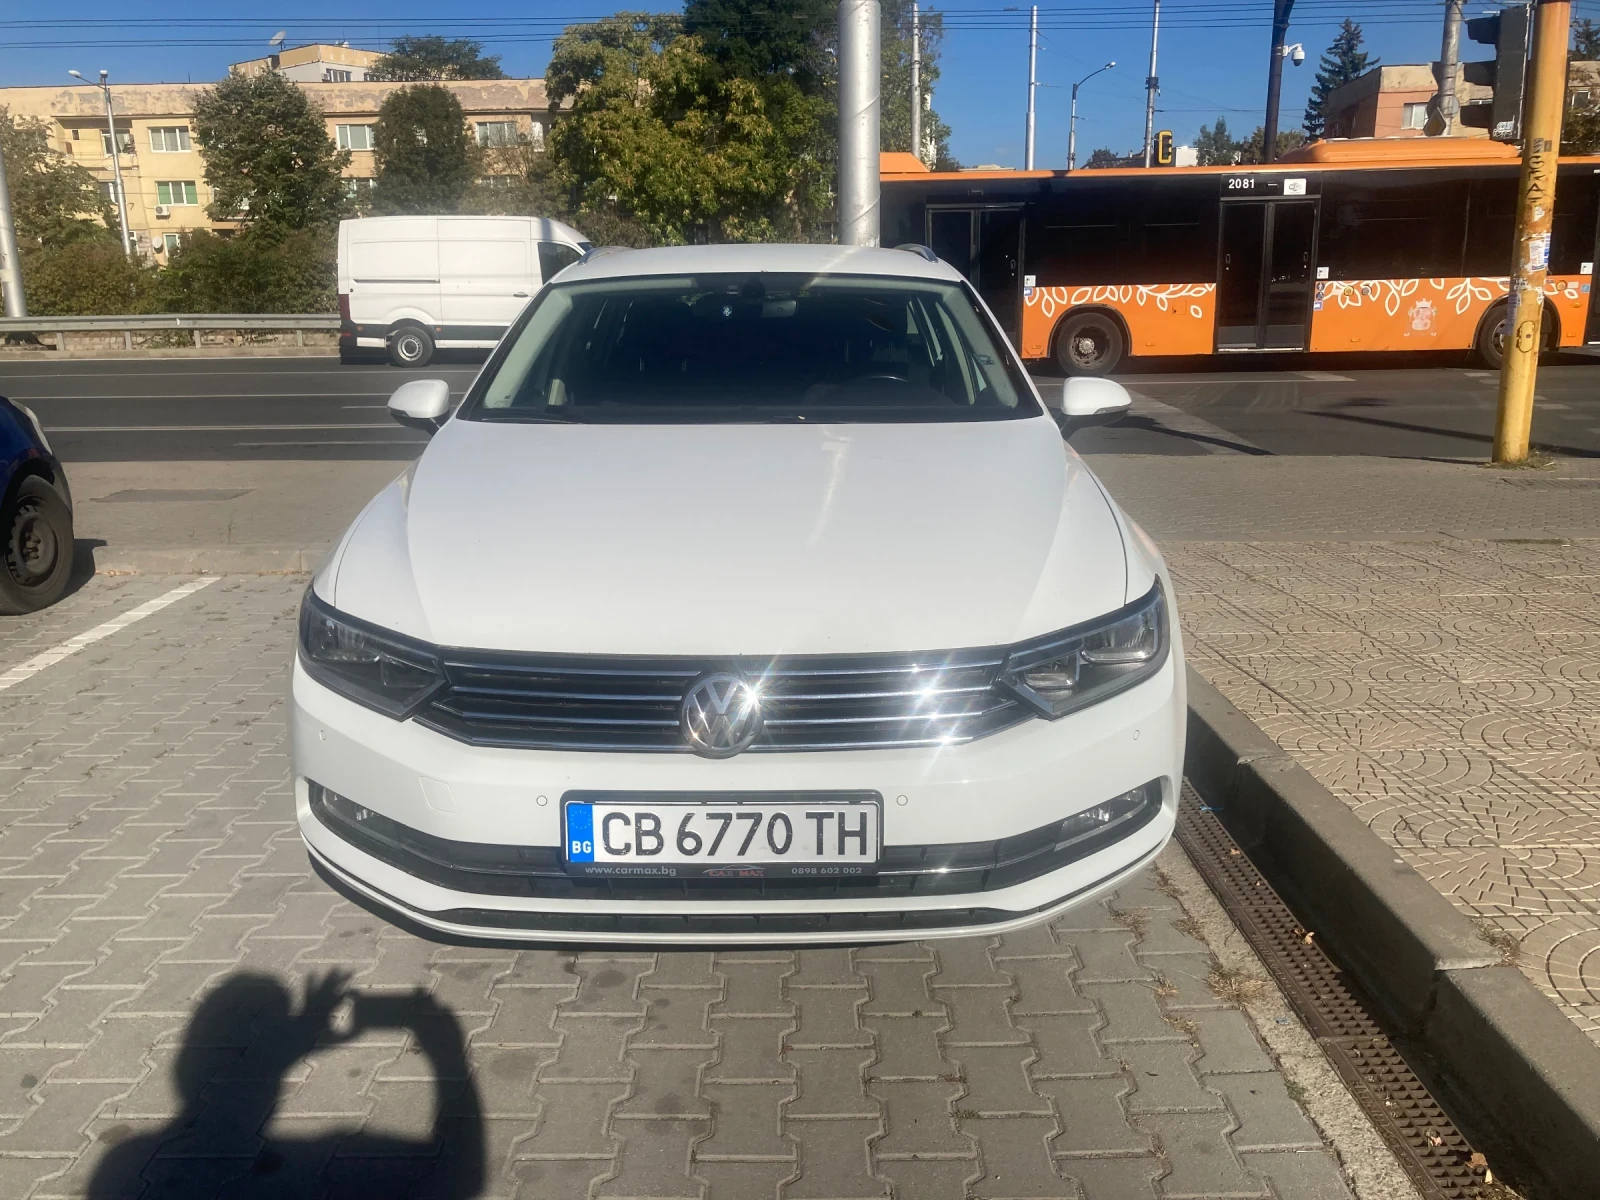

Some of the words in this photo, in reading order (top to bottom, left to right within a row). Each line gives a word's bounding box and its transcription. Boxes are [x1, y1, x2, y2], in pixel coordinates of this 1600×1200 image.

[1228, 178, 1255, 189] 2081
[684, 676, 757, 752] VW
[601, 811, 664, 856] CB
[676, 811, 793, 857] 6770
[805, 811, 868, 856] TH
[572, 840, 592, 854] BG
[585, 866, 677, 877] www.carmax.bg
[708, 869, 734, 877] CAR
[738, 869, 765, 877] MAX
[791, 867, 818, 875] 0898
[820, 867, 840, 875] 602
[842, 867, 862, 875] 002
